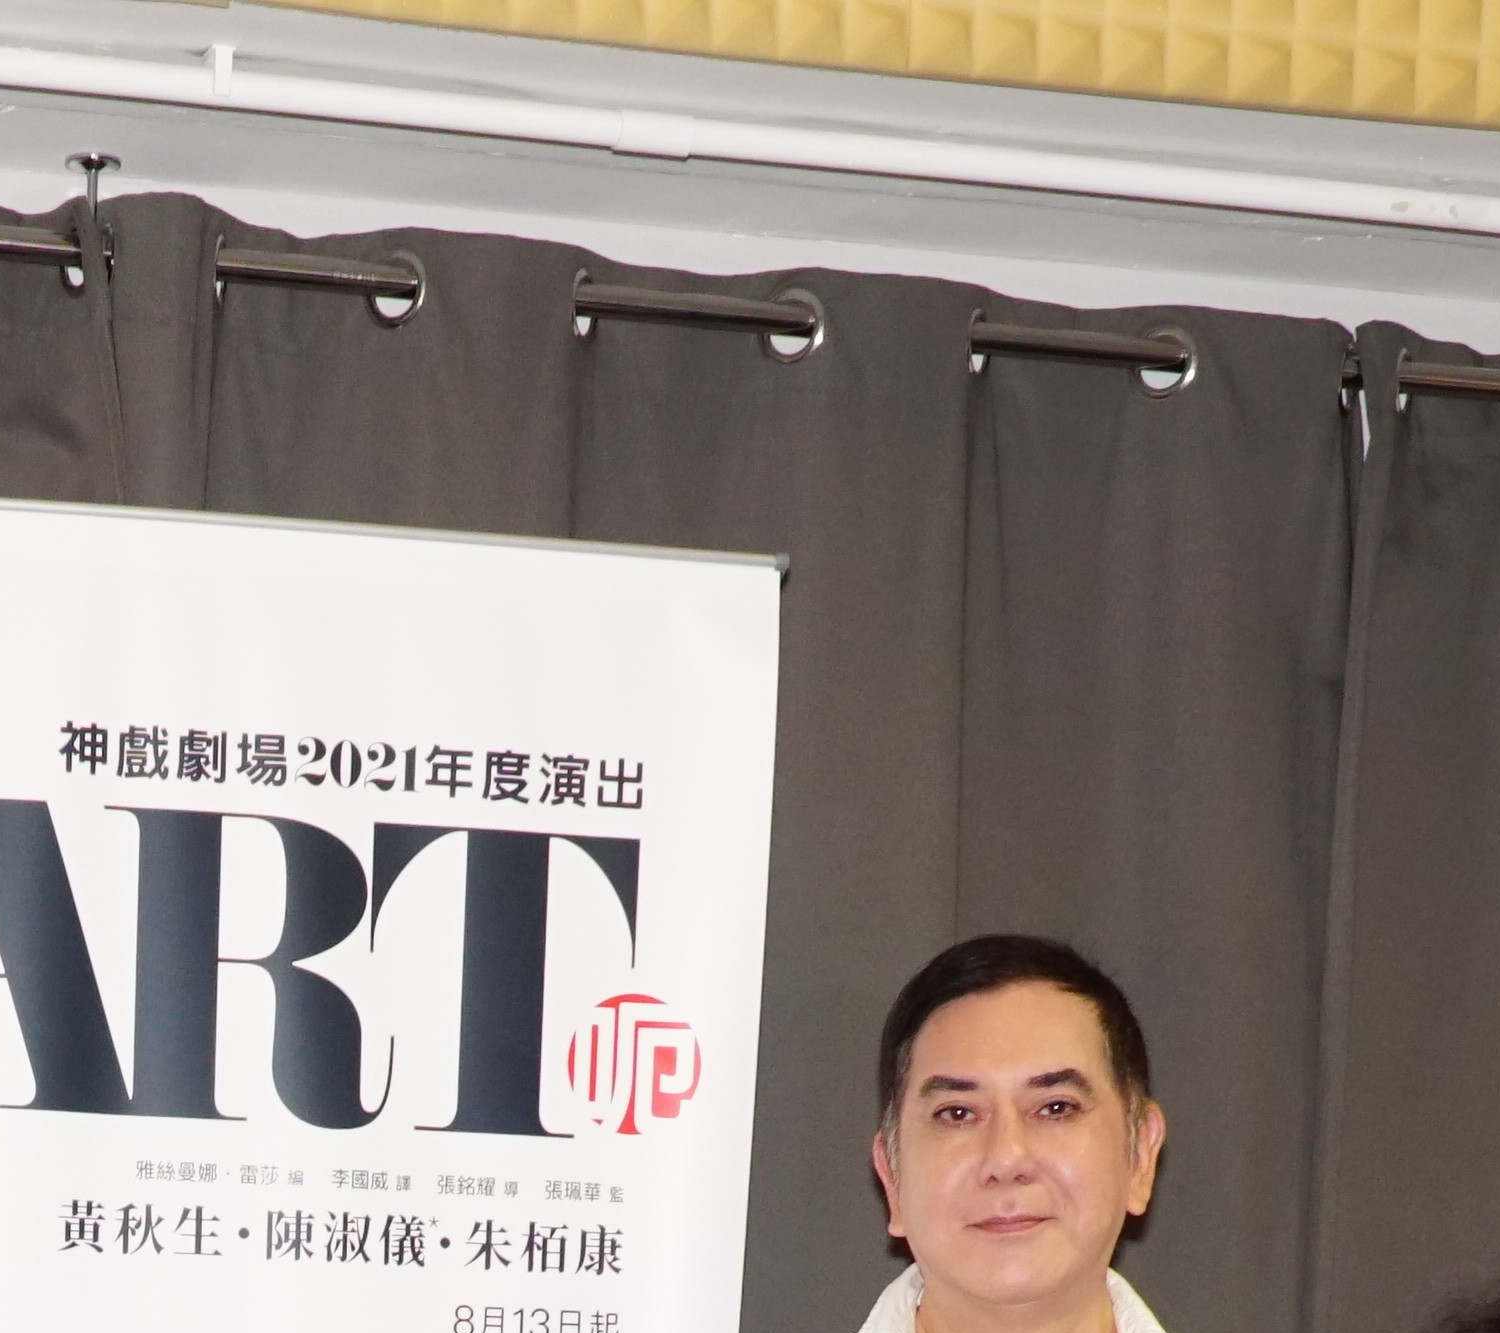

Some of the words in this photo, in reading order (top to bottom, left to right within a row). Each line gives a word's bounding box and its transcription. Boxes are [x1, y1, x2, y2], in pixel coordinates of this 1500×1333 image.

[58, 720, 645, 811] 神戲劇場2021年度演出
[331, 1168, 389, 1191] 李國威
